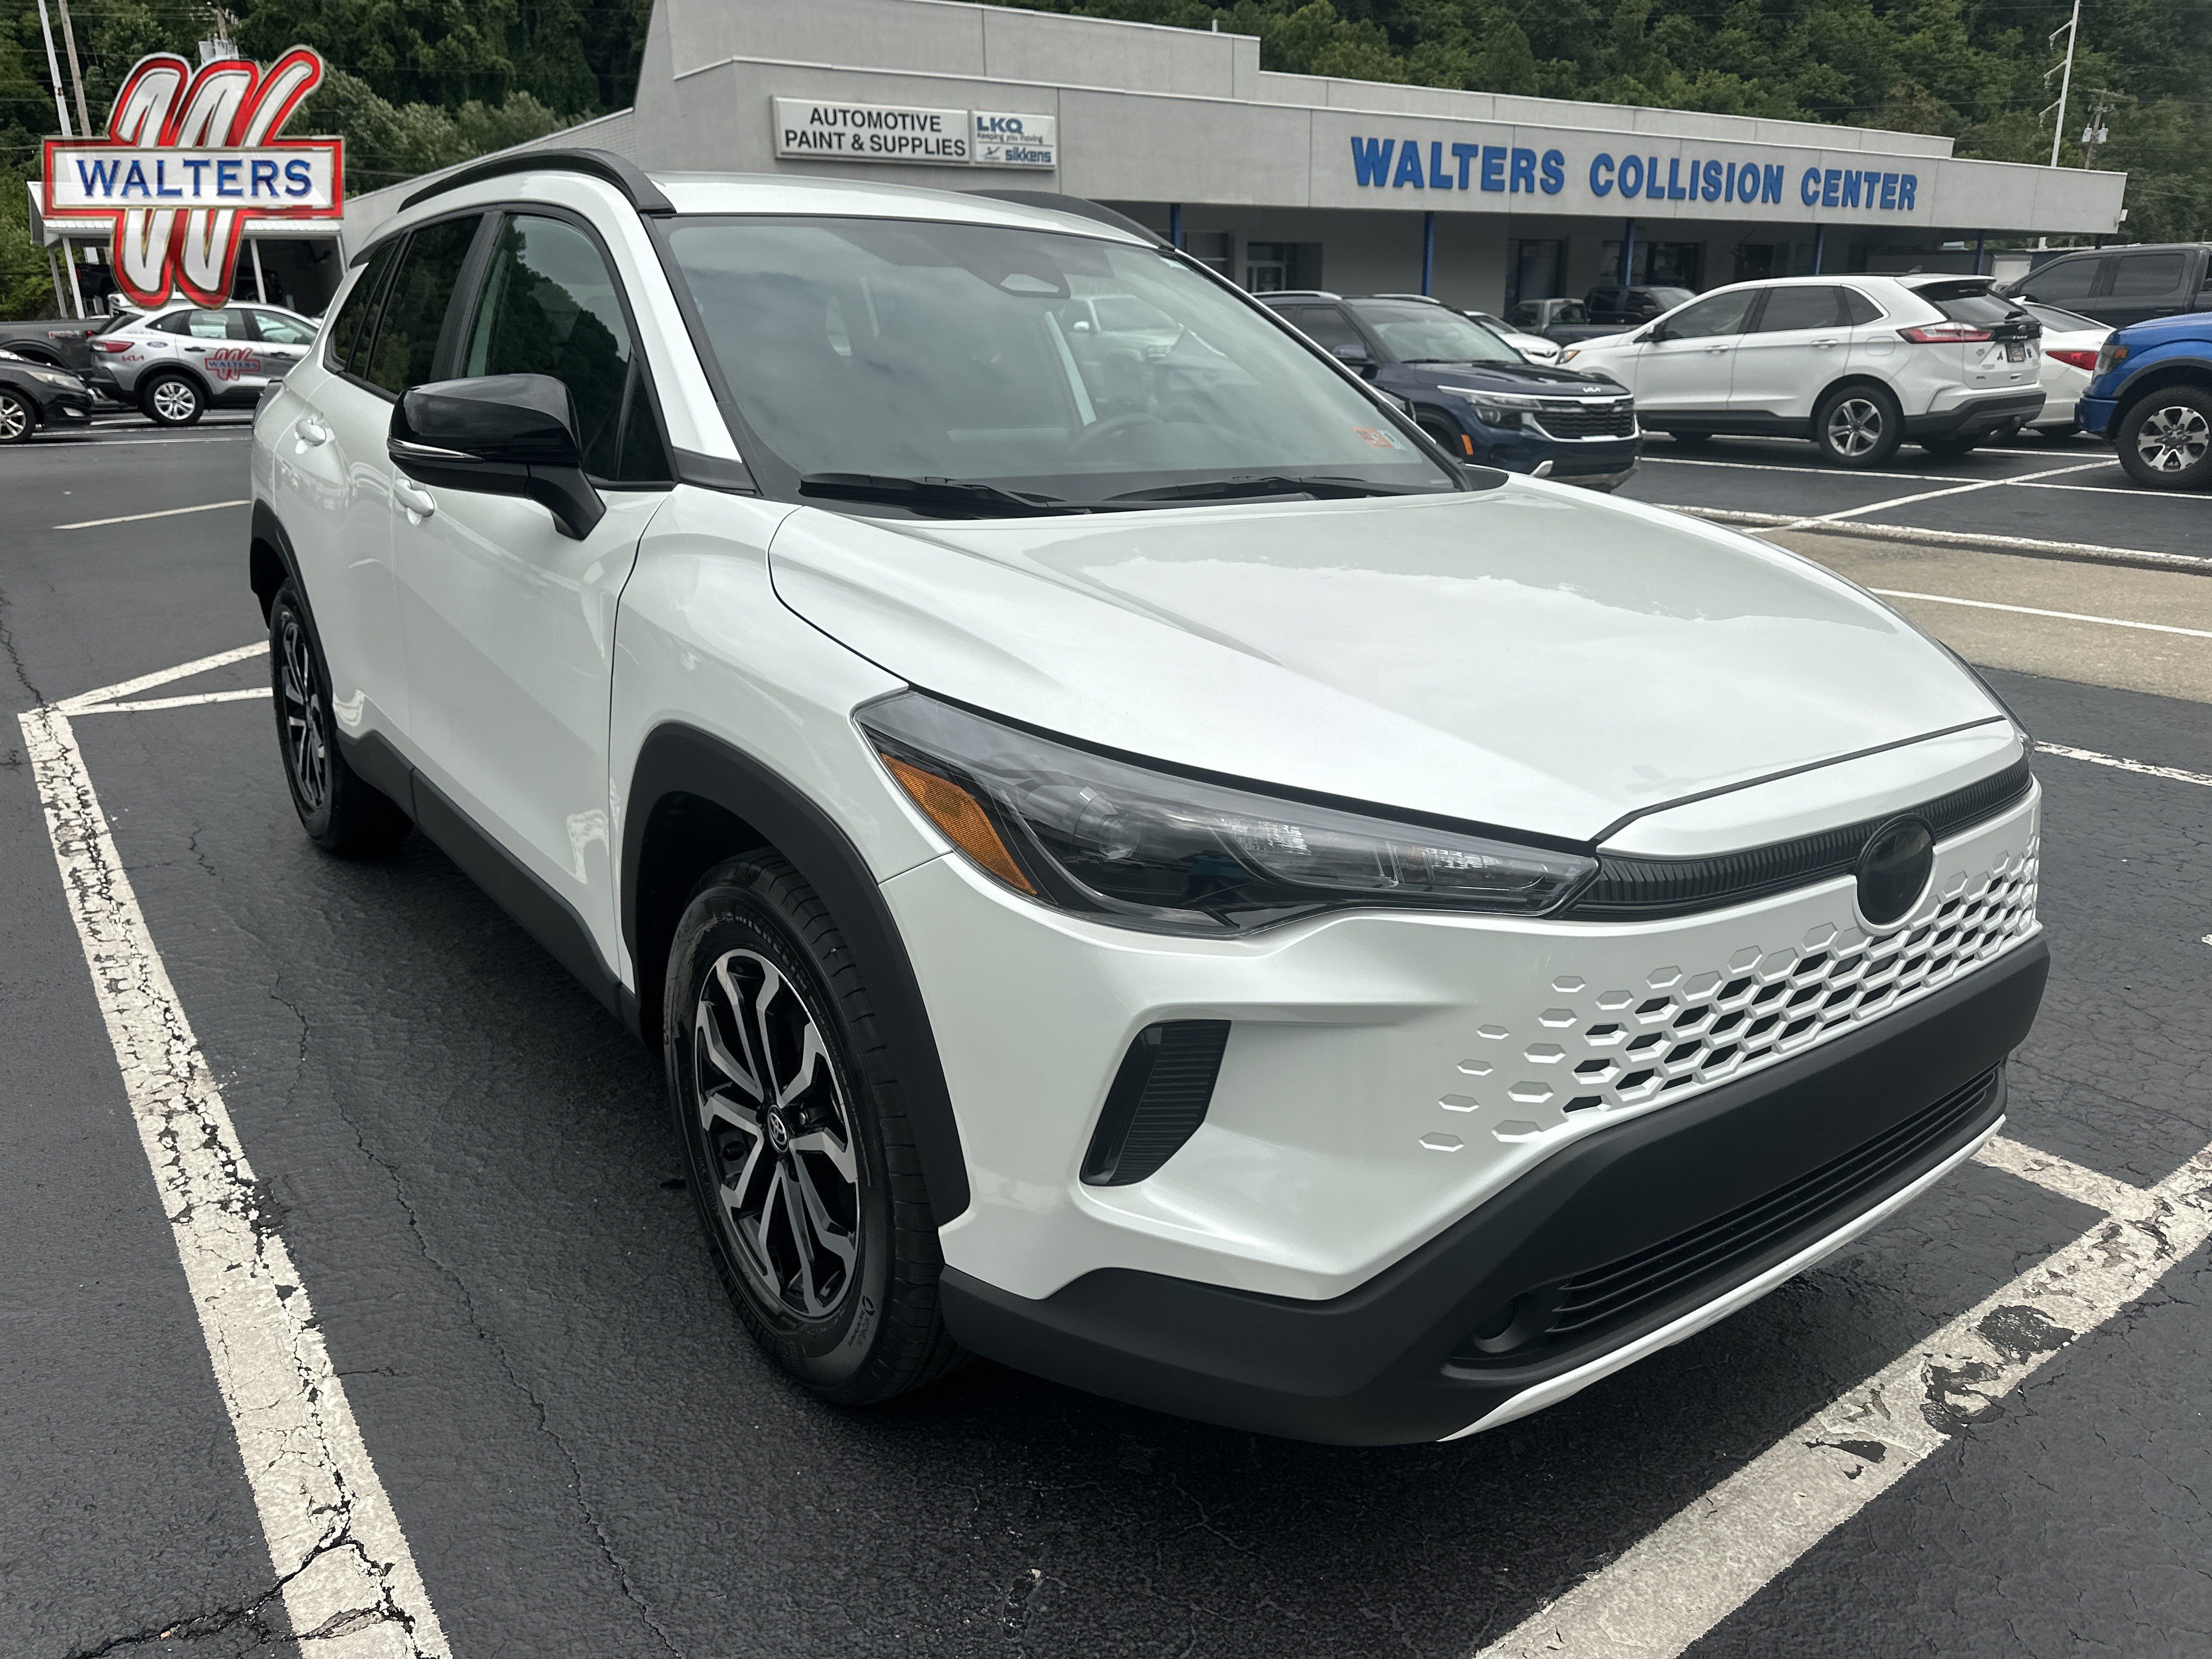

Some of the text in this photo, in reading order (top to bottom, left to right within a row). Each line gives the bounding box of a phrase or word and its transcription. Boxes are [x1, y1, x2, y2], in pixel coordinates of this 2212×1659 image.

[810, 107, 942, 133] AUTOMOTIVE
[977, 116, 1024, 134] LKQ
[785, 129, 846, 150] PAINT
[851, 133, 865, 152] &
[869, 134, 966, 157] SUPPLIES
[1005, 146, 1051, 163] sikkens
[1351, 136, 1918, 210] WALTERS COLLISION CENTER
